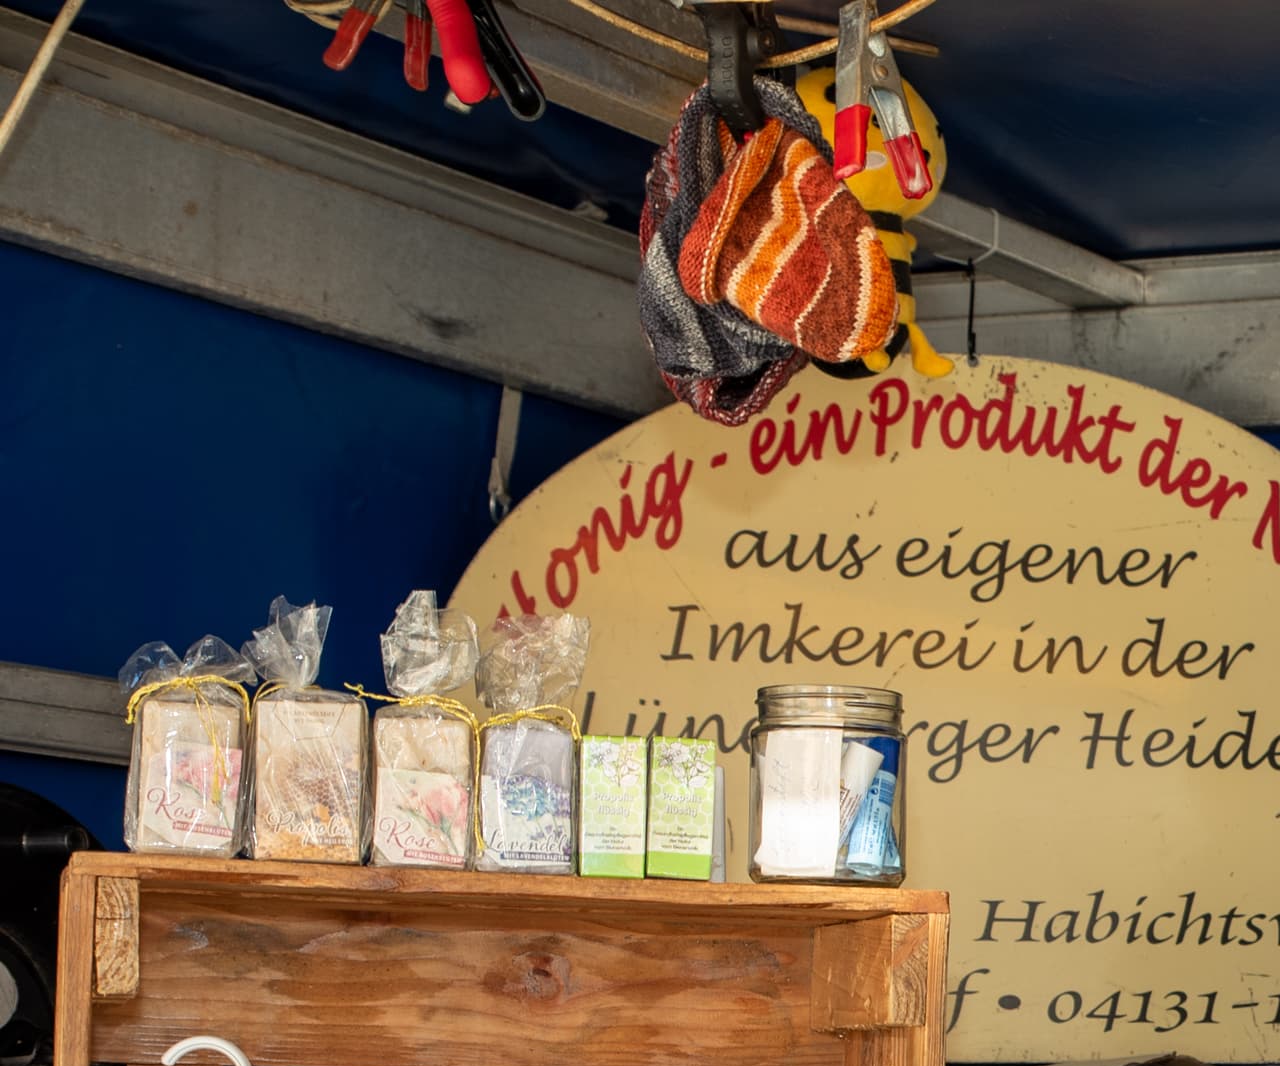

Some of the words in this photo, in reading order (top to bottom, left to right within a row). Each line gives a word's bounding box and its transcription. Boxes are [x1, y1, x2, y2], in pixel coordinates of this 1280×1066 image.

[750, 393, 862, 475] ein
[868, 373, 1136, 474] Produkt
[1138, 415, 1248, 520] der
[724, 528, 882, 580] aus
[896, 527, 1197, 603] eigener
[660, 602, 996, 671] Imkerei
[1012, 620, 1107, 675] in
[1121, 617, 1255, 681] der
[581, 692, 1060, 784] ünerger
[379, 816, 436, 849] Rose
